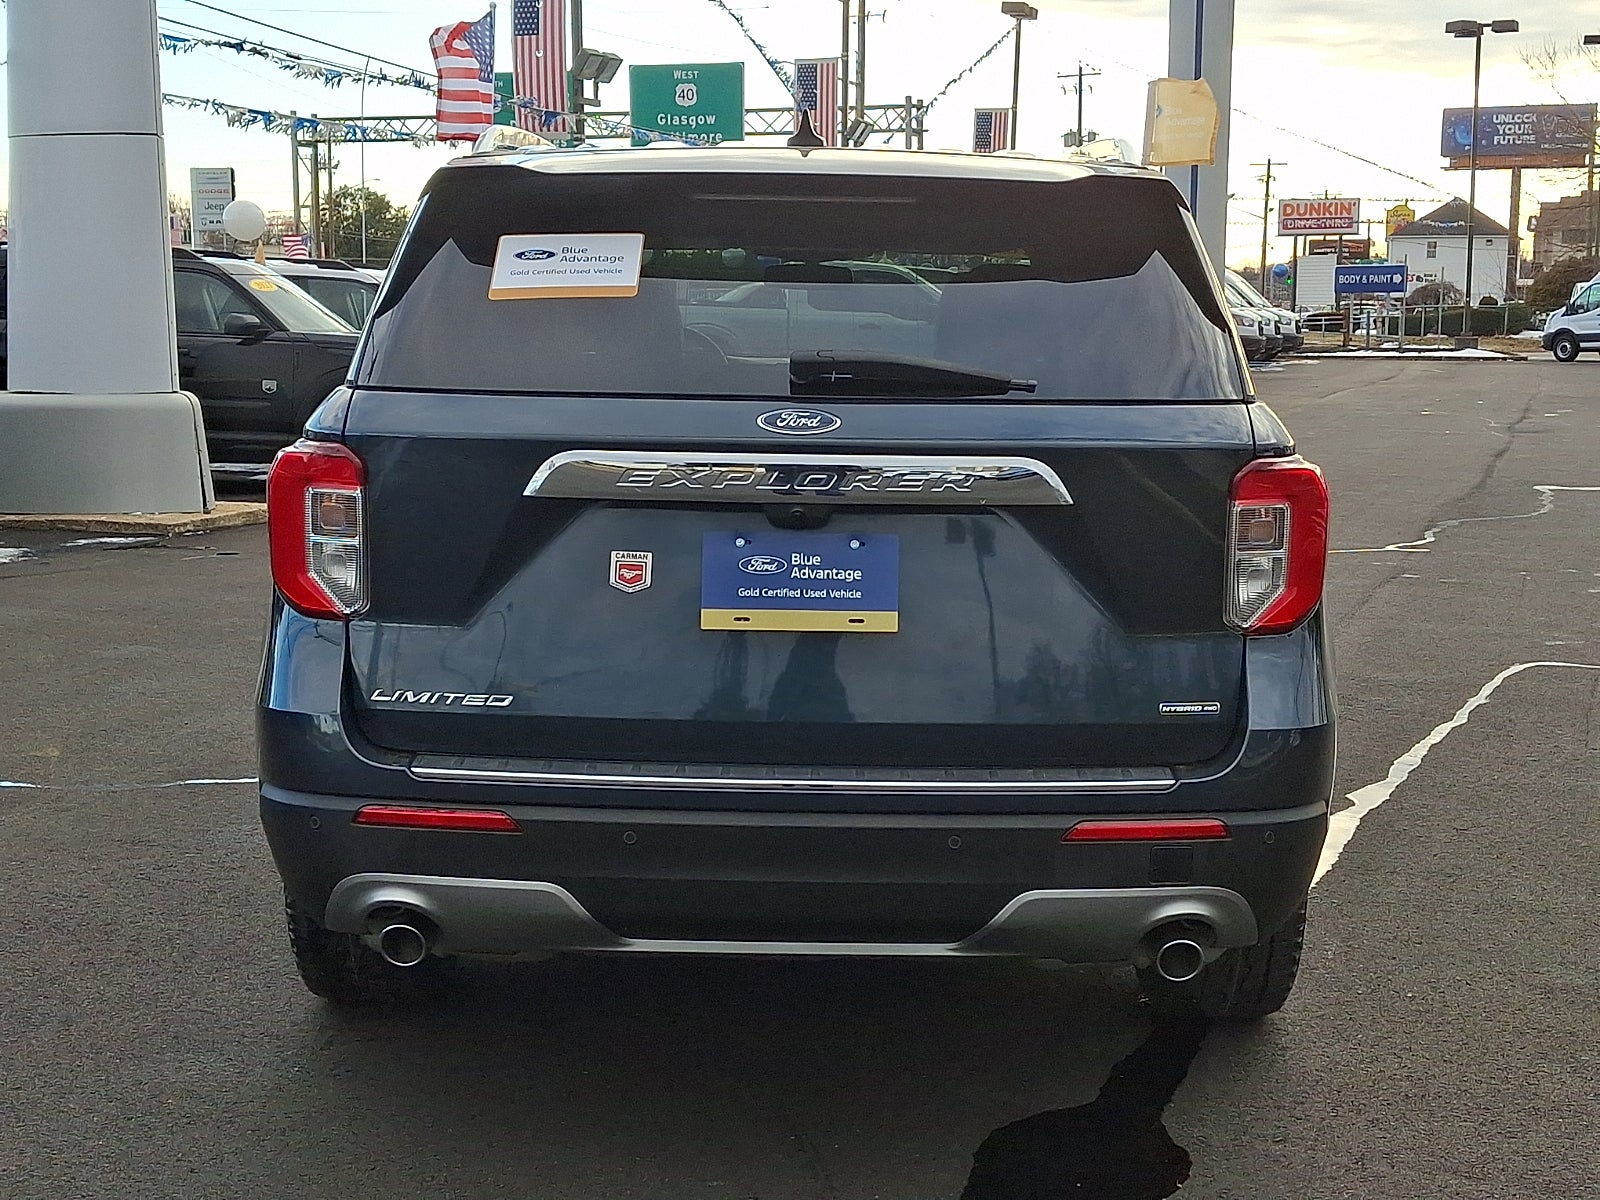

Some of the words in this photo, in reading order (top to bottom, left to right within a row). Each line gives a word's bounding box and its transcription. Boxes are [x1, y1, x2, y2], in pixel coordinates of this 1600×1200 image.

[673, 70, 699, 79] WEST
[677, 88, 695, 101] 40
[657, 113, 716, 129] Glasgow
[1492, 113, 1537, 123] UNLOCK
[1496, 124, 1532, 134] YOUR
[1493, 135, 1536, 145] FUTURE
[204, 202, 225, 211] Jeep
[1283, 202, 1357, 217] DUNKIN'
[520, 249, 551, 261] Ford
[561, 246, 588, 254] Blue
[560, 254, 625, 264] Advantage
[531, 268, 567, 276] Certified
[593, 267, 623, 275] Vehicle
[1338, 274, 1361, 284] BODY
[1361, 274, 1368, 284] &
[1368, 274, 1392, 284] PAINT
[775, 411, 822, 427] Ford
[615, 467, 976, 492] EXPLORER
[615, 552, 649, 560] CARMAN
[791, 553, 821, 566] Blue
[746, 557, 779, 571] Ford
[790, 567, 863, 582] Advantage
[738, 587, 760, 598] Gold
[761, 588, 801, 598] Certified
[803, 588, 827, 598] Used
[829, 589, 862, 599] Vehicle
[370, 688, 514, 707] LIMITED
